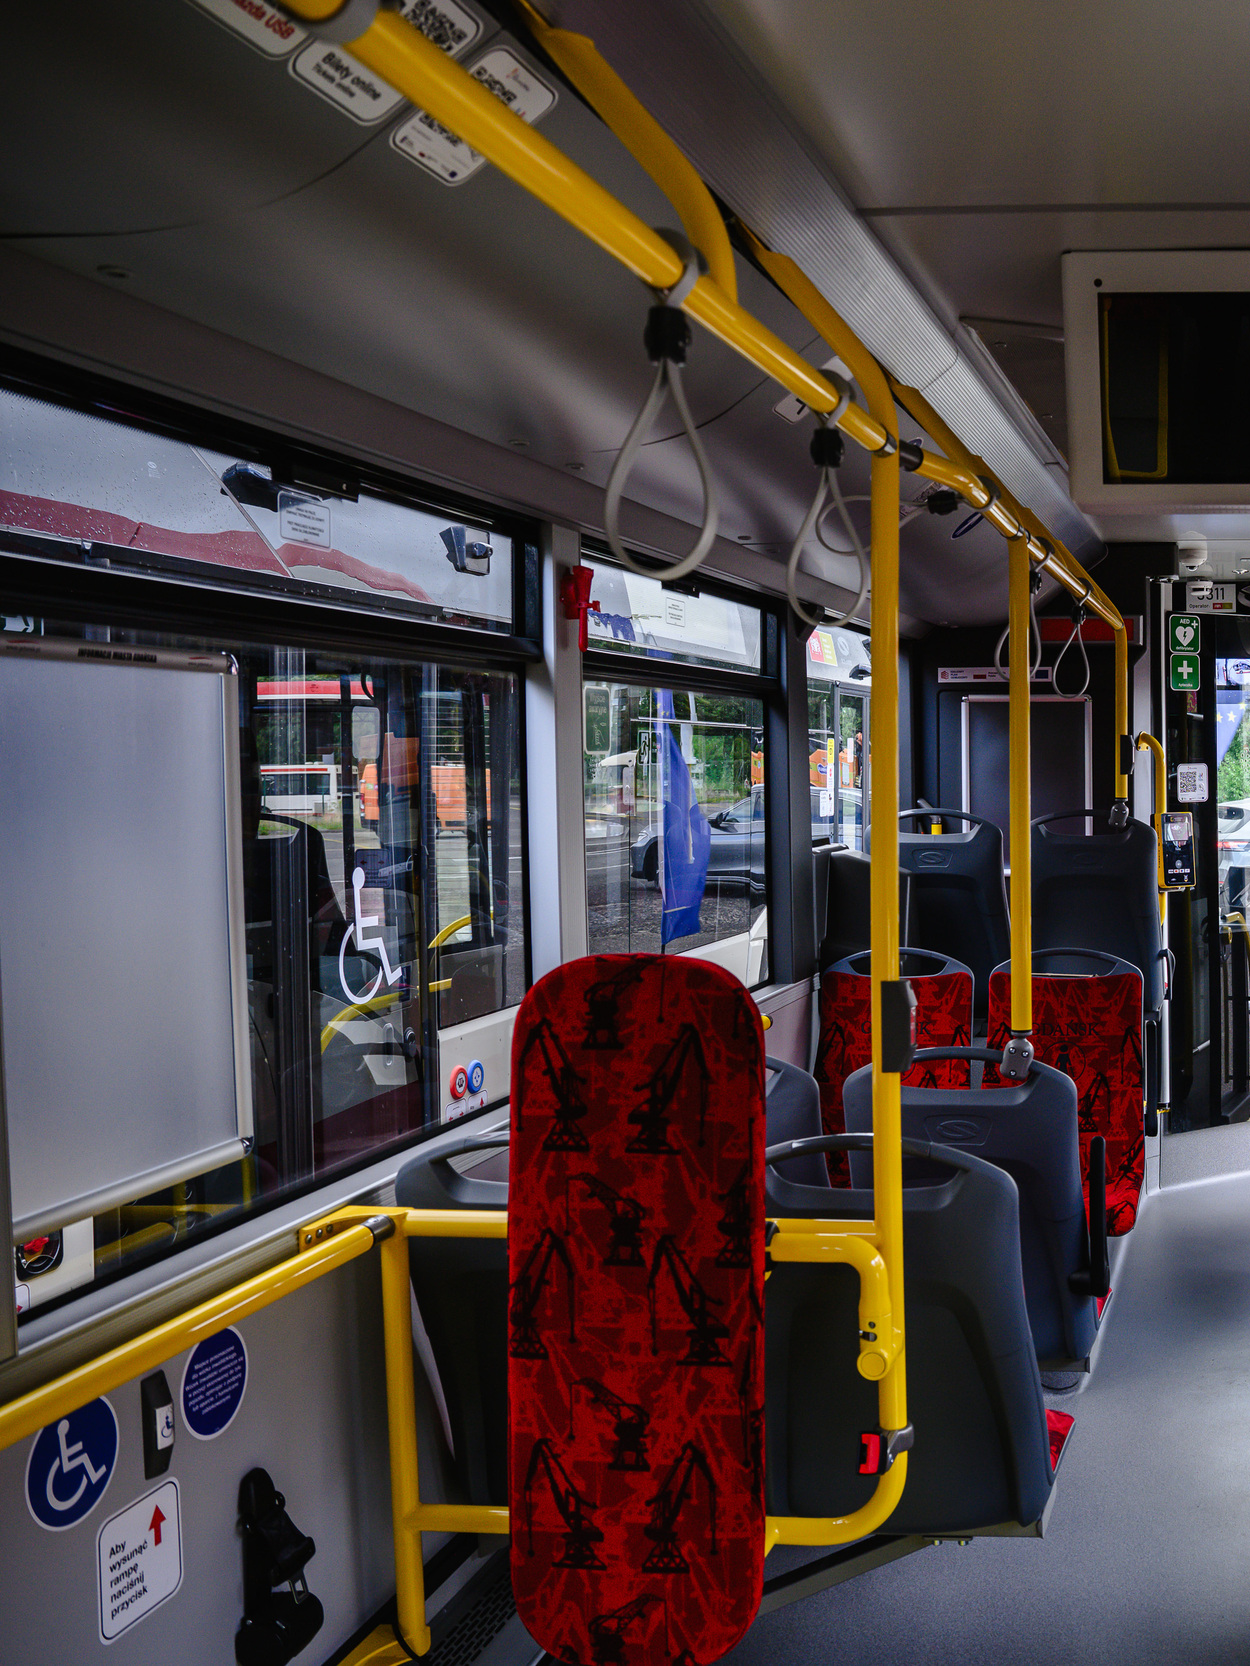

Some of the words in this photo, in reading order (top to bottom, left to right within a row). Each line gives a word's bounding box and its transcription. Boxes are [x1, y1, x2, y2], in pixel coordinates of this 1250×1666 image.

[264, 14, 295, 40] USB
[321, 51, 353, 80] Bilety
[350, 76, 382, 101] online
[335, 82, 356, 98] online
[1197, 587, 1225, 600] 311
[109, 1540, 126, 1558] Aby
[109, 1539, 148, 1573] wysunąć
[110, 1563, 138, 1588] rampę
[110, 1570, 144, 1604] naciśnij
[111, 1585, 148, 1620] przycisk
